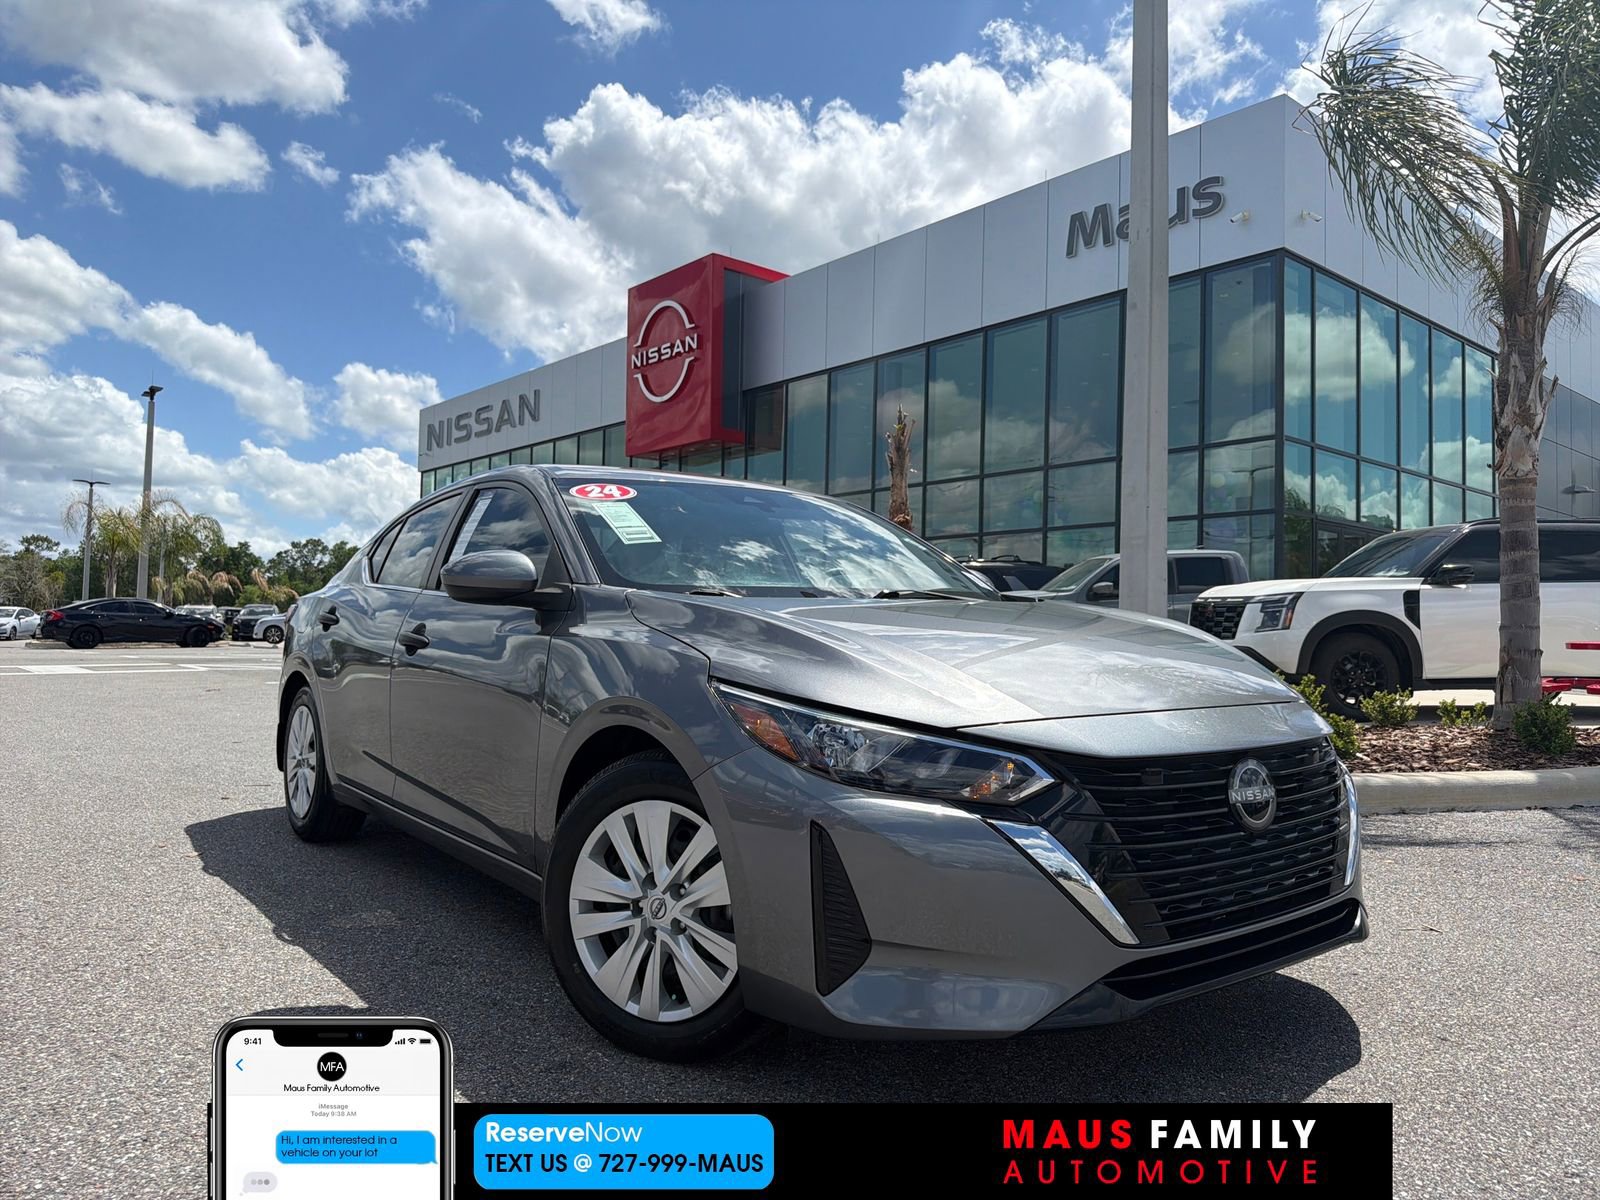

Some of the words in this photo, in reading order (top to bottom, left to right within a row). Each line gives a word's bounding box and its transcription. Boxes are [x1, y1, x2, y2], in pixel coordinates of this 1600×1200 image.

[631, 333, 698, 369] NISSAN
[426, 389, 541, 452] NISSAN
[584, 484, 623, 498] 24
[1231, 788, 1274, 801] NISSAN
